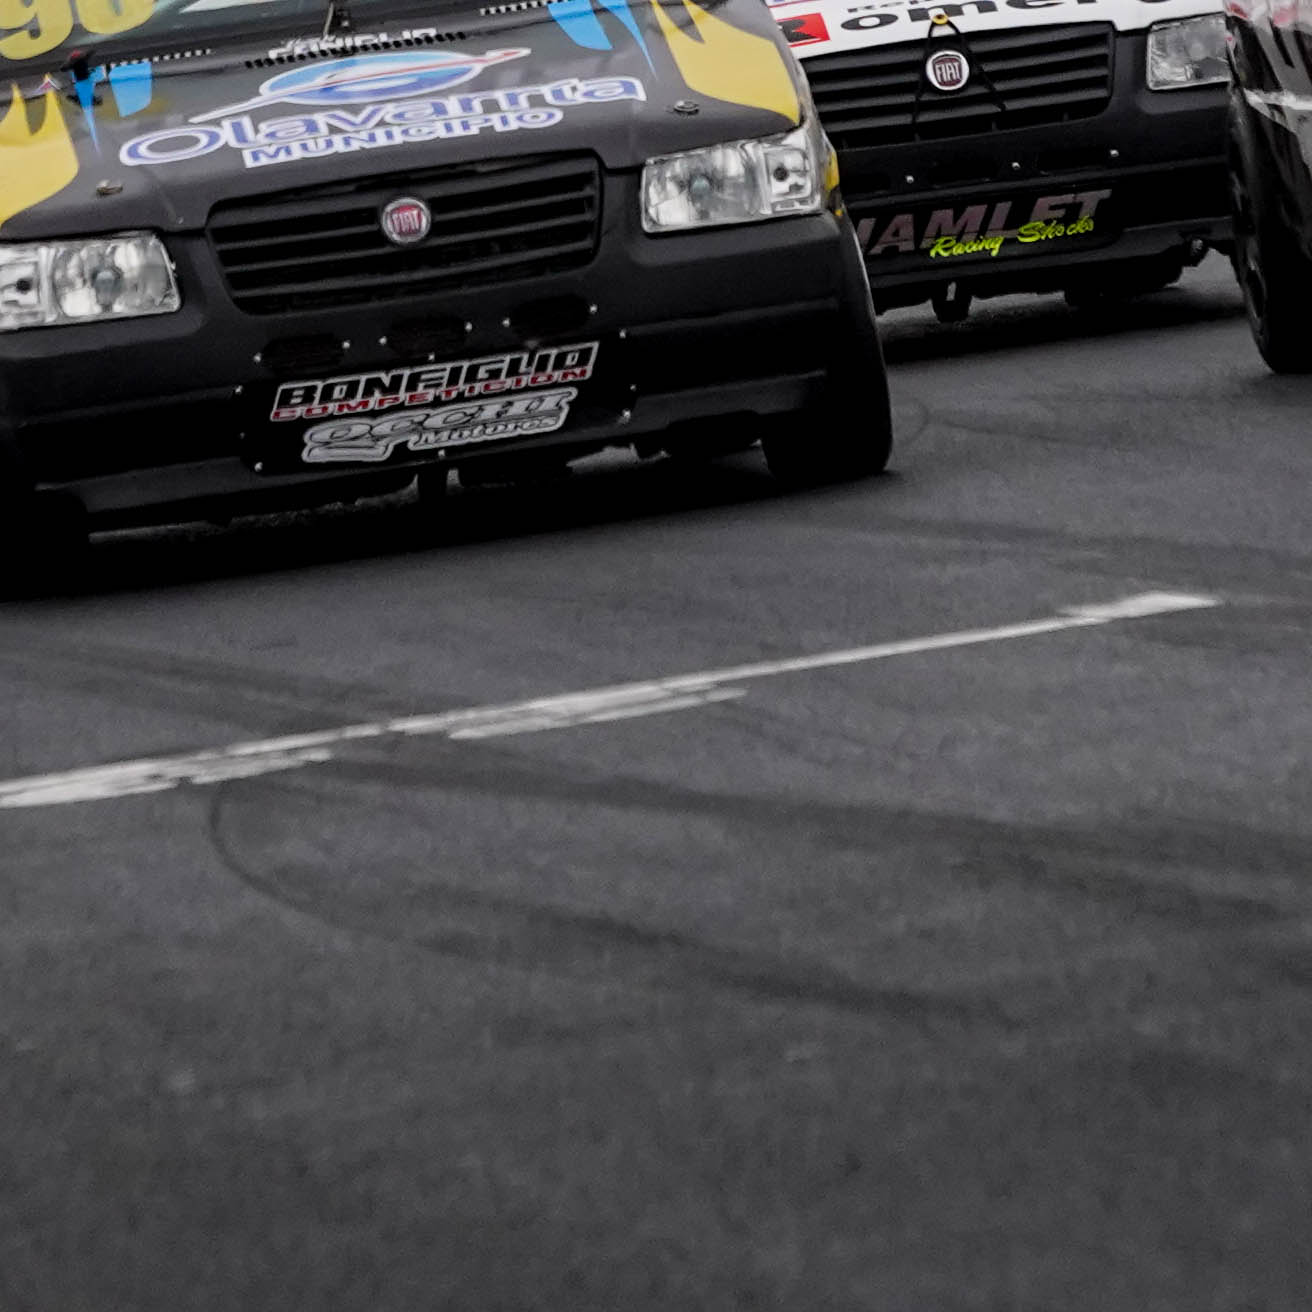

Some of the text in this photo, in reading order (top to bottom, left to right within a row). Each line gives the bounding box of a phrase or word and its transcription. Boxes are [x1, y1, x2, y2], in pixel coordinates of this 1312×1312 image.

[935, 62, 961, 83] FIAT
[244, 108, 564, 169] MUNICIPIO
[930, 216, 1095, 259] Racing Shocks
[272, 368, 591, 420] COMPETICION
